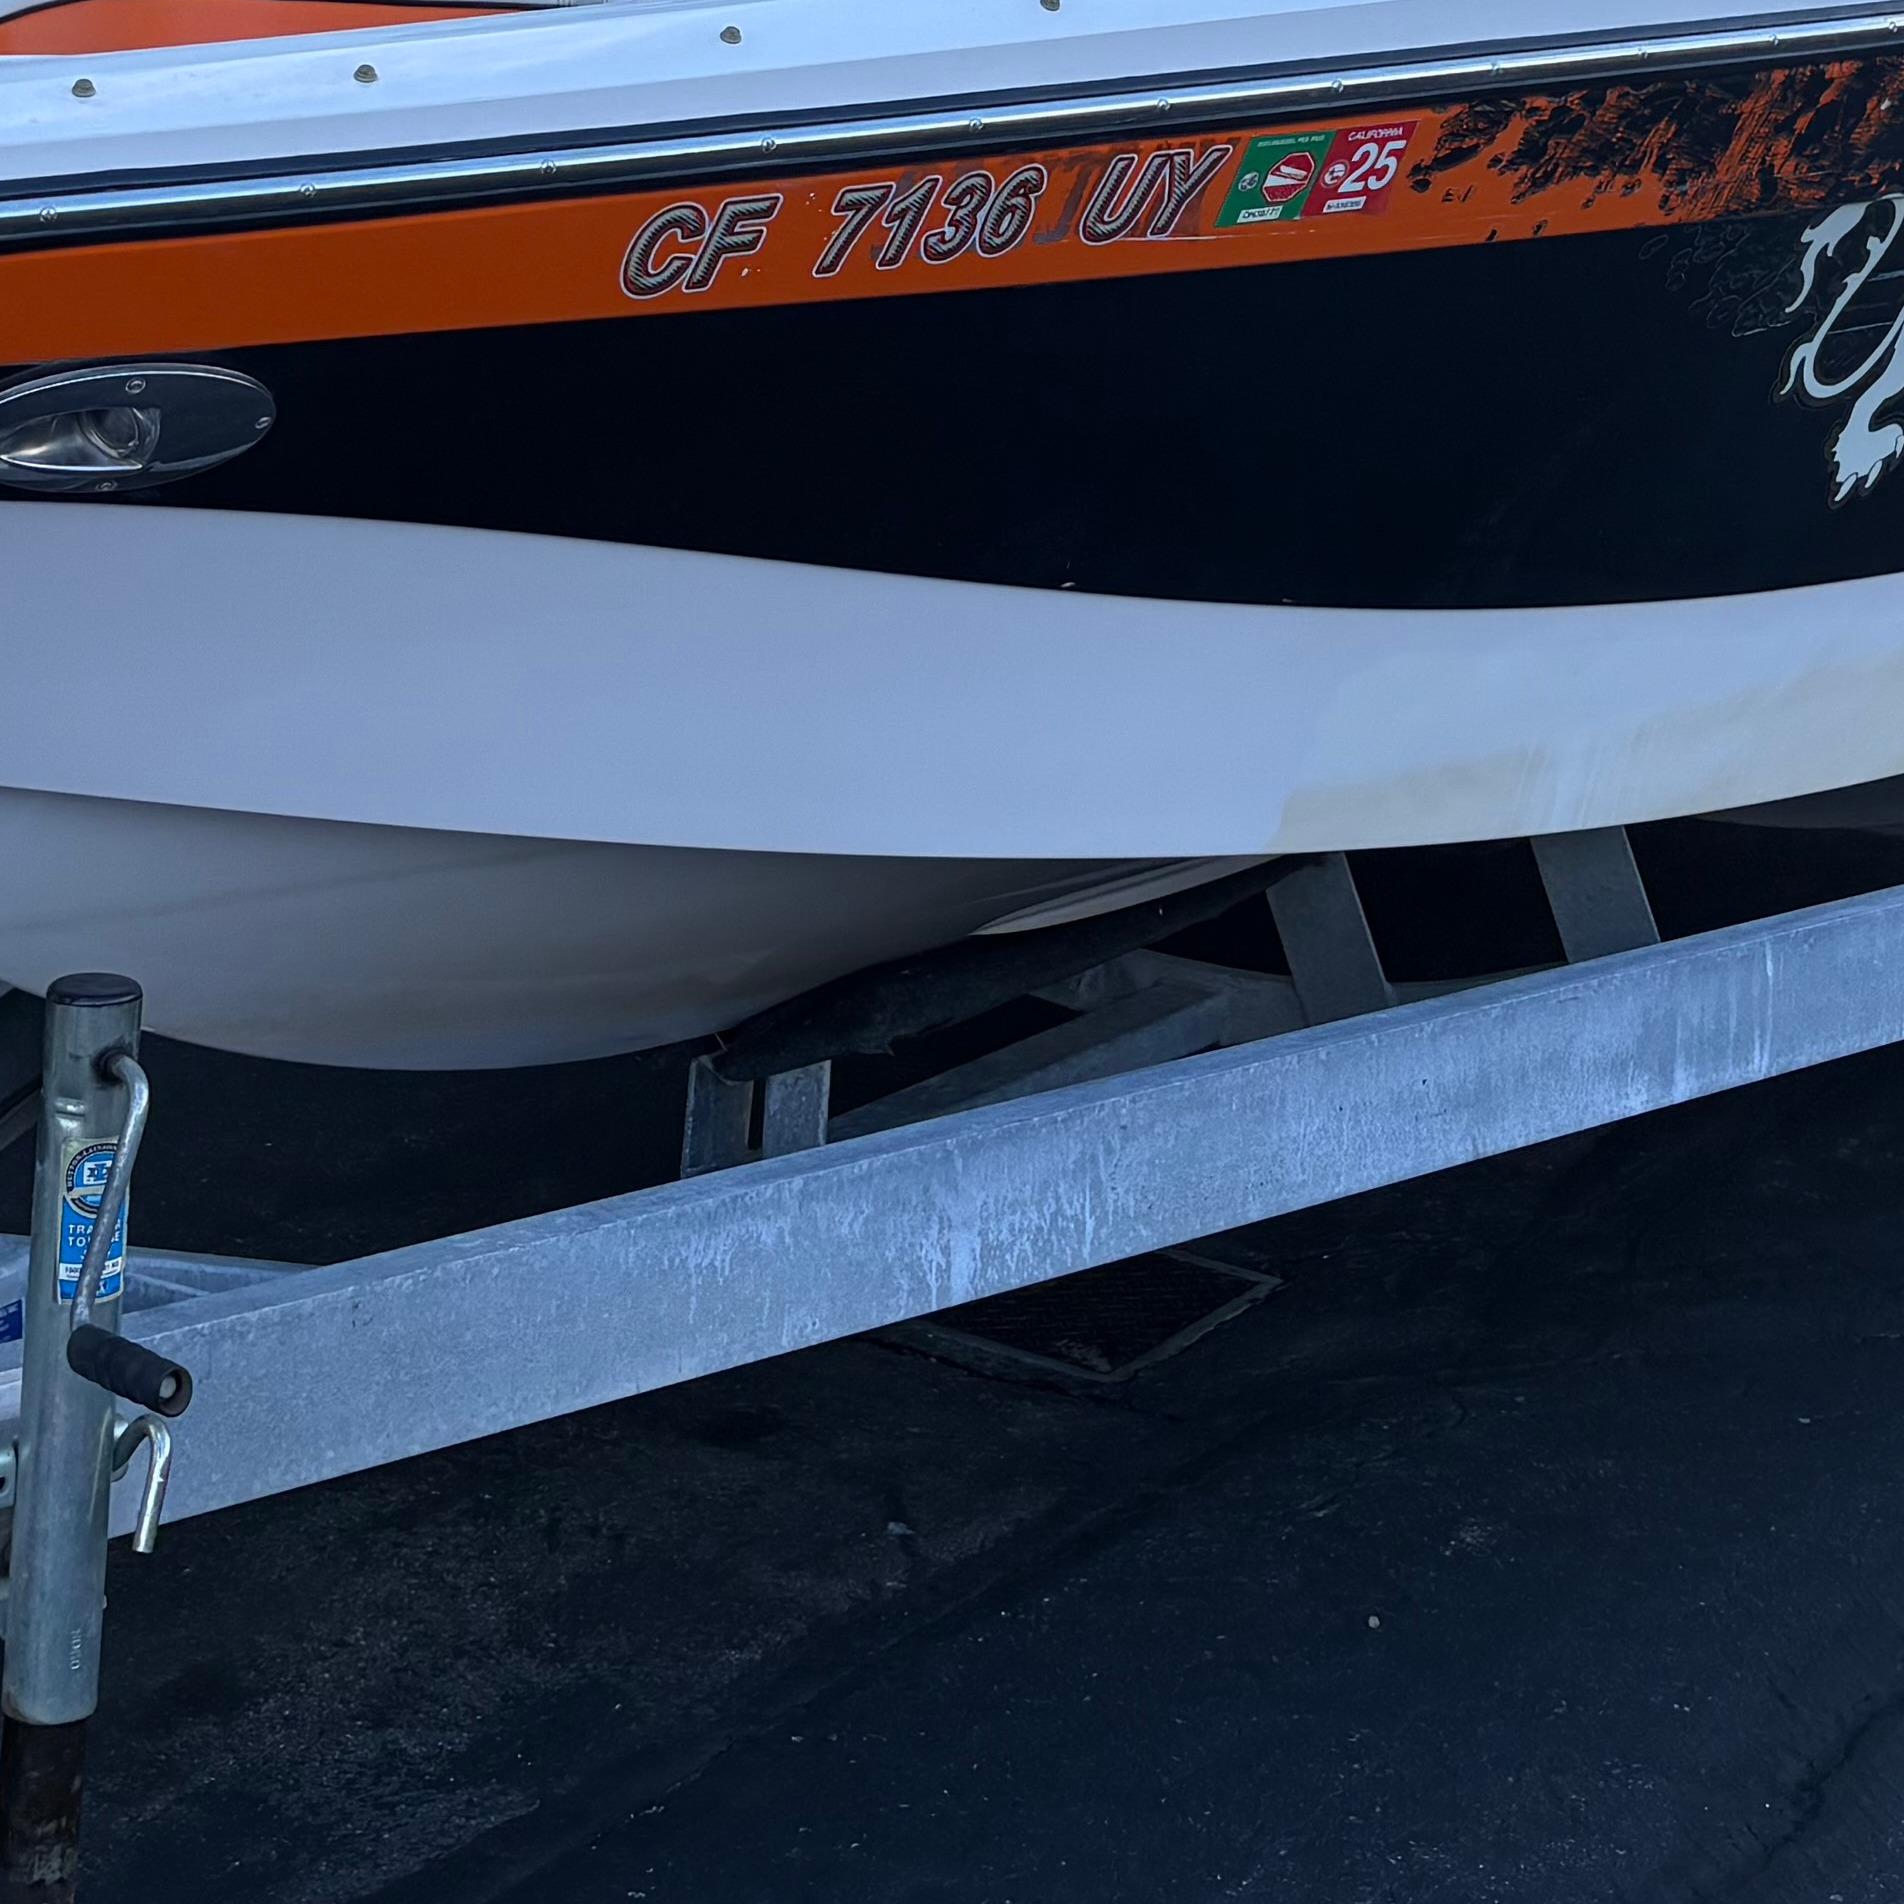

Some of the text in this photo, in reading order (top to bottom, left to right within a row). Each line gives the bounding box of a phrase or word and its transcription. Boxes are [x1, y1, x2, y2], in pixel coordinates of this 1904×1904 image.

[1337, 139, 1407, 193] 25
[620, 144, 1234, 300] CF 7136 UY
